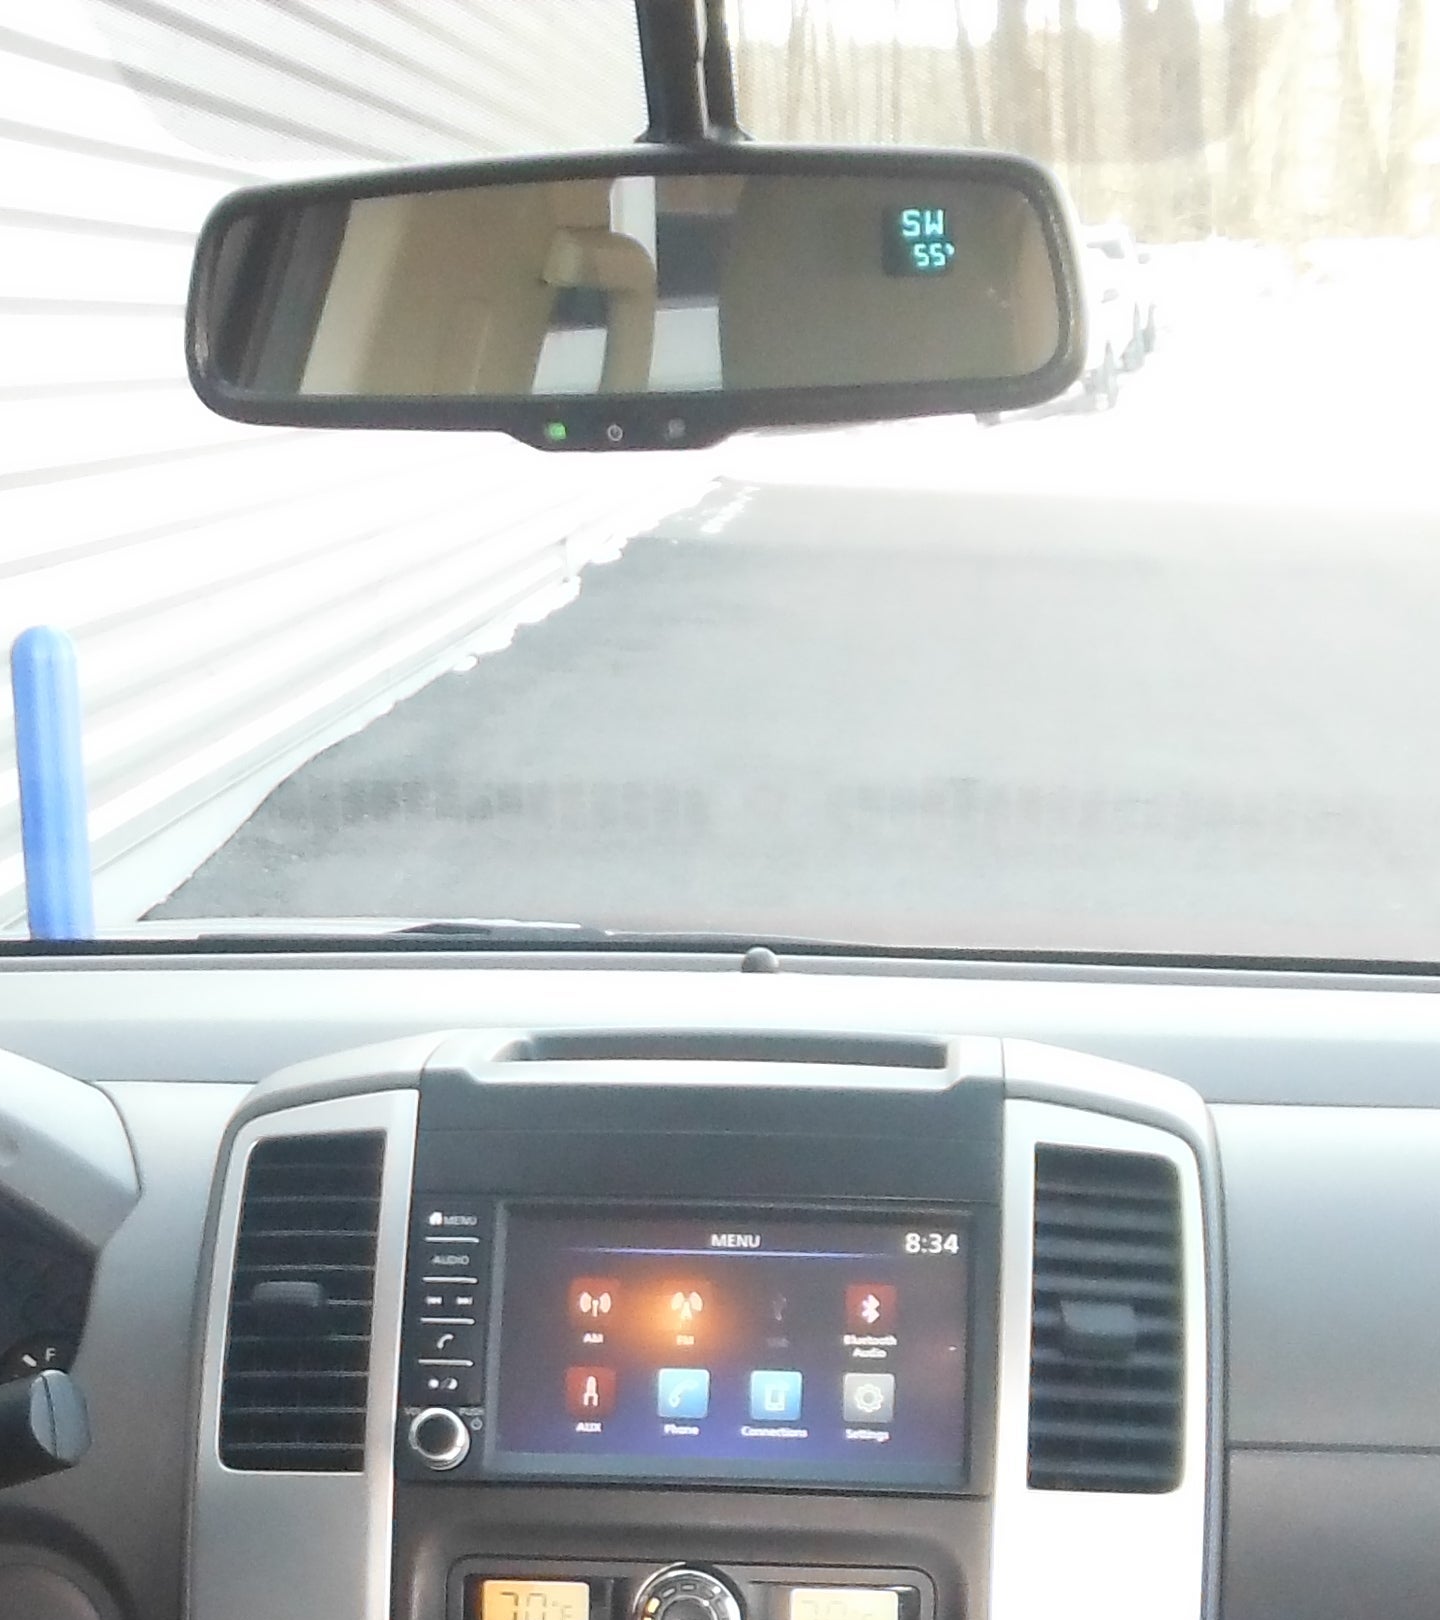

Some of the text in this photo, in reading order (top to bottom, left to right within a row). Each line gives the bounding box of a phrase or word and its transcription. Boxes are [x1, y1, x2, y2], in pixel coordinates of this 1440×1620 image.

[902, 208, 944, 236] SW
[710, 1233, 761, 1249] MENU
[904, 1232, 959, 1255] 8:34
[582, 1332, 605, 1344] AM
[676, 1334, 695, 1346] FM
[44, 1346, 57, 1362] F
[575, 1421, 603, 1434] AUX
[663, 1423, 700, 1436] Phone
[740, 1425, 809, 1439] Connections
[845, 1428, 891, 1443] Settings
